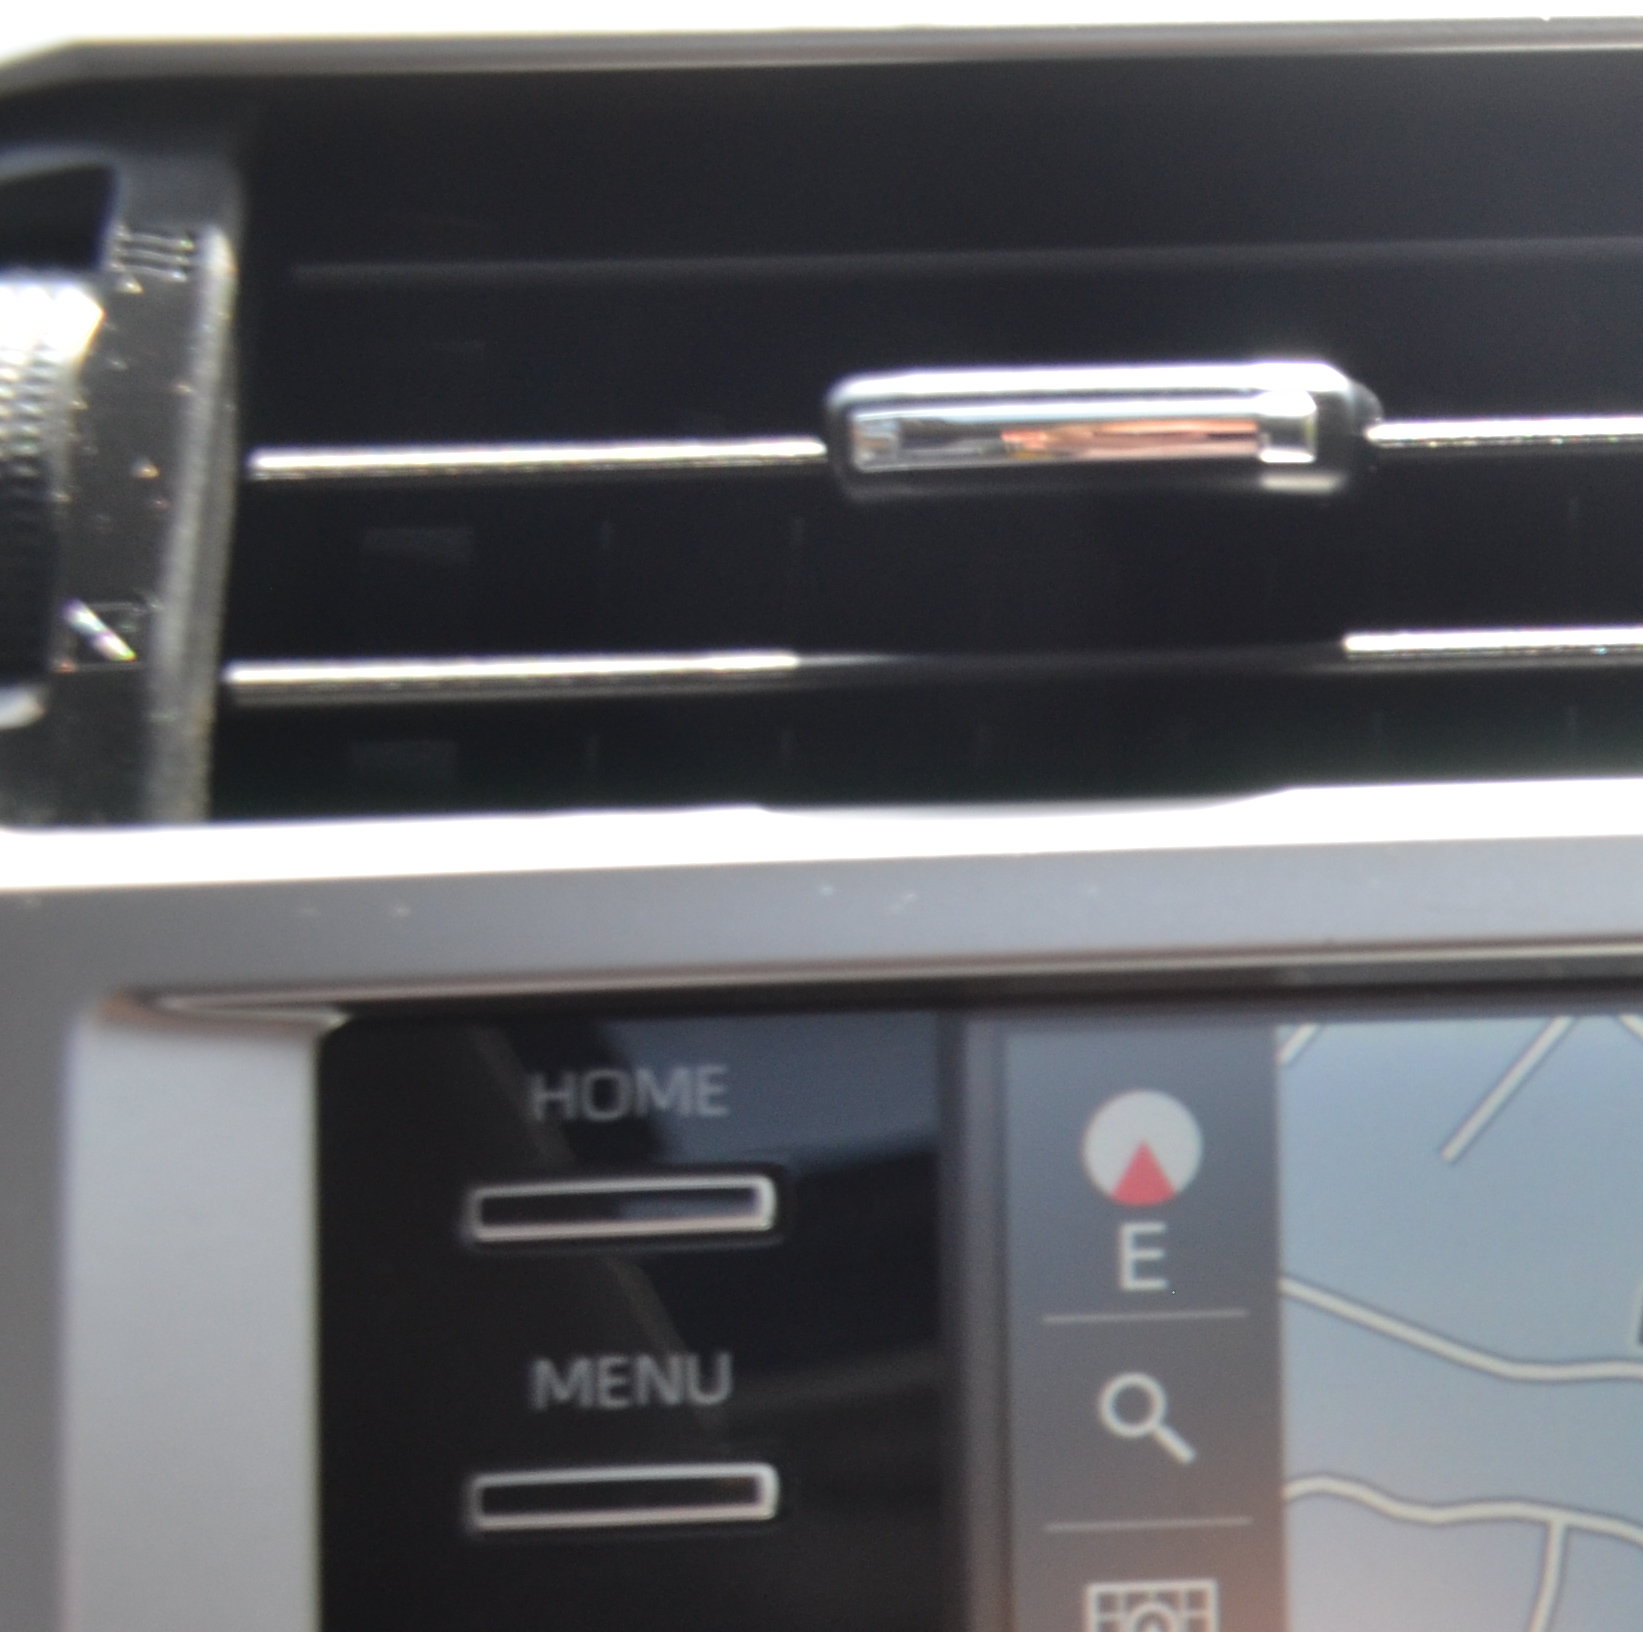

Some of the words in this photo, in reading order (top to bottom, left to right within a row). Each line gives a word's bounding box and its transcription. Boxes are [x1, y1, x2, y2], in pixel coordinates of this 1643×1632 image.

[527, 1064, 730, 1122] HOME
[1117, 1222, 1166, 1292] E
[530, 1351, 733, 1410] MENU
